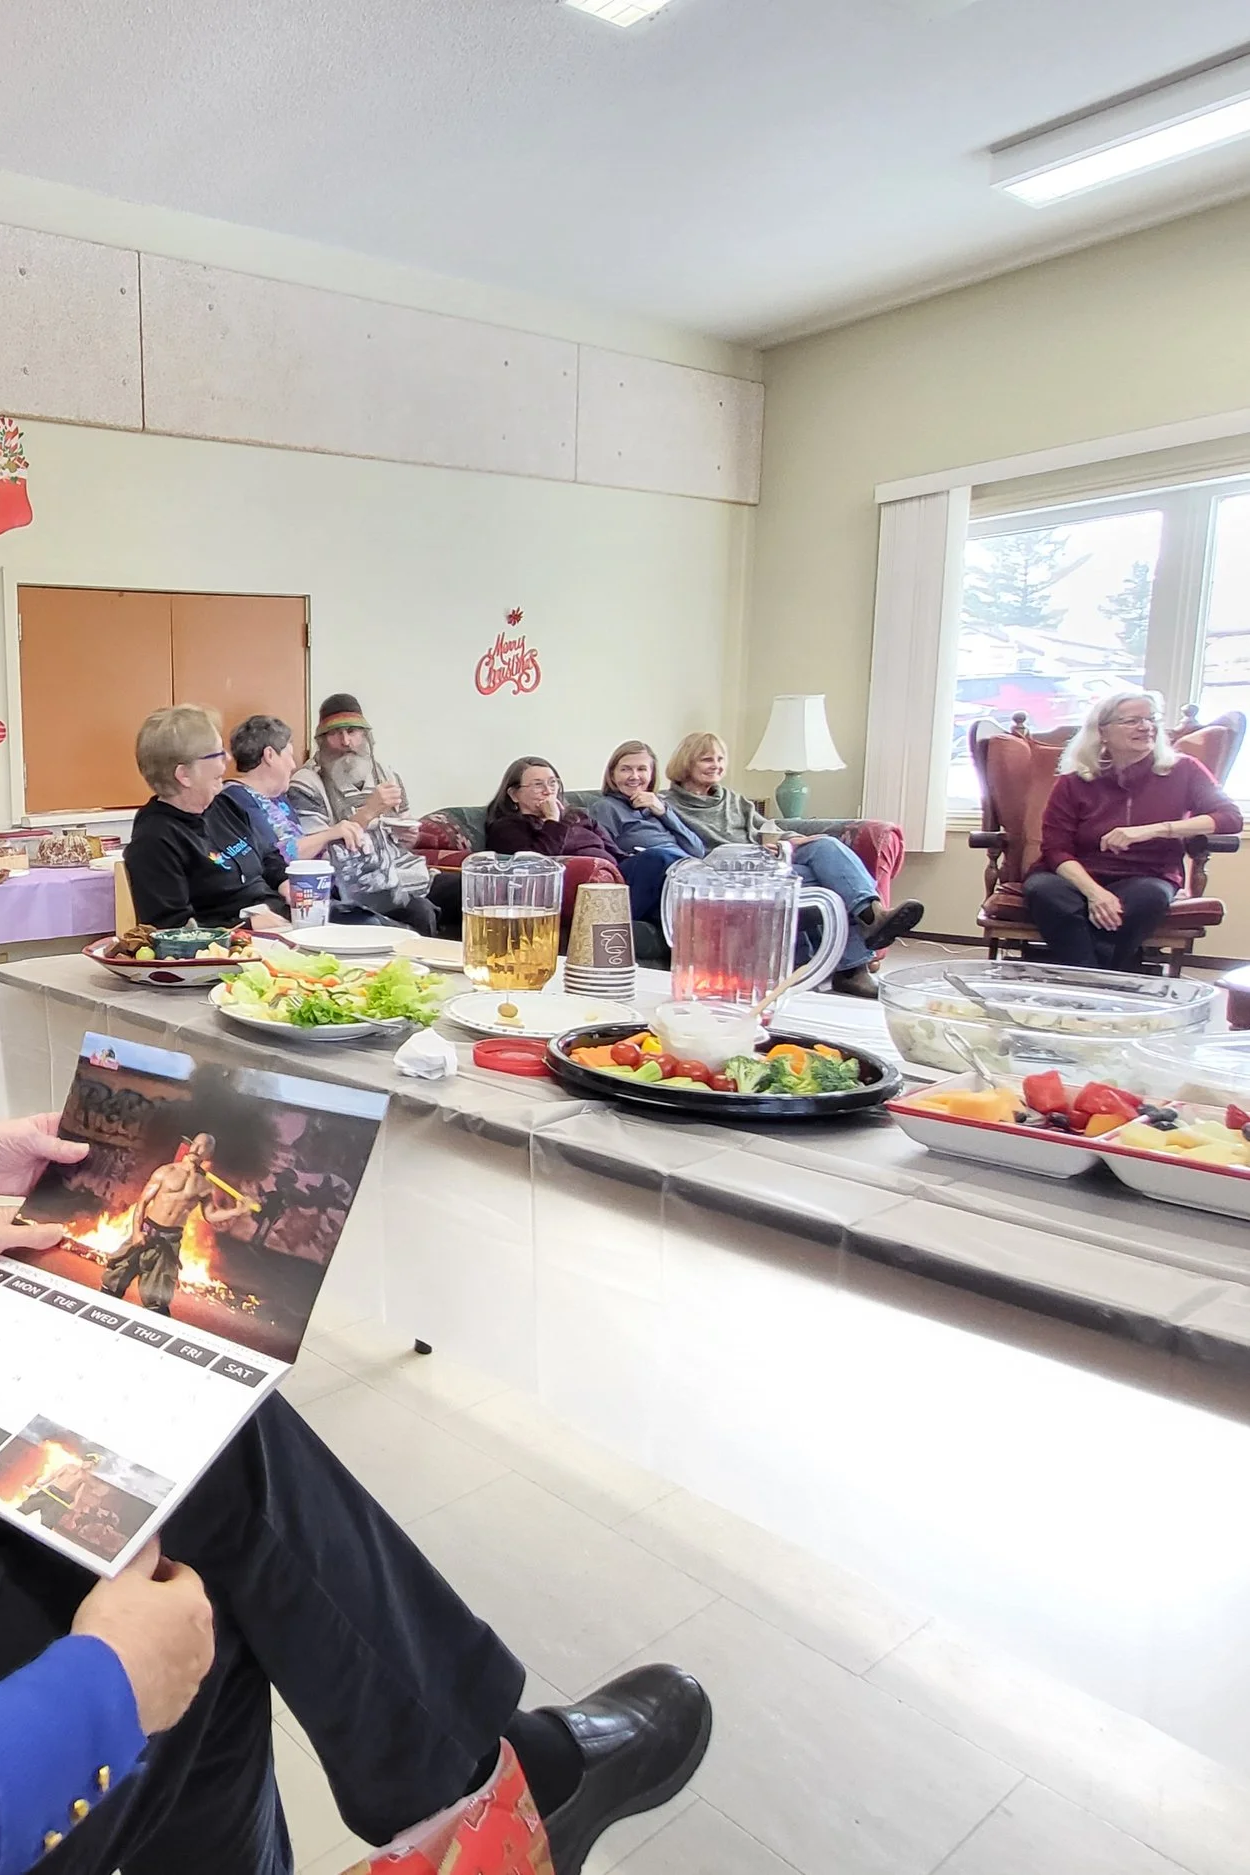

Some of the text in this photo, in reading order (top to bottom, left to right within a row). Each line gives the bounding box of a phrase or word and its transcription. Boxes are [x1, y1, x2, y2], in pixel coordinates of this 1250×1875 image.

[11, 1279, 42, 1295] MON
[53, 1294, 78, 1309] TUE
[90, 1308, 119, 1326] WED
[133, 1326, 162, 1343] THU
[179, 1344, 203, 1360] FRI
[223, 1362, 254, 1380] SAT
